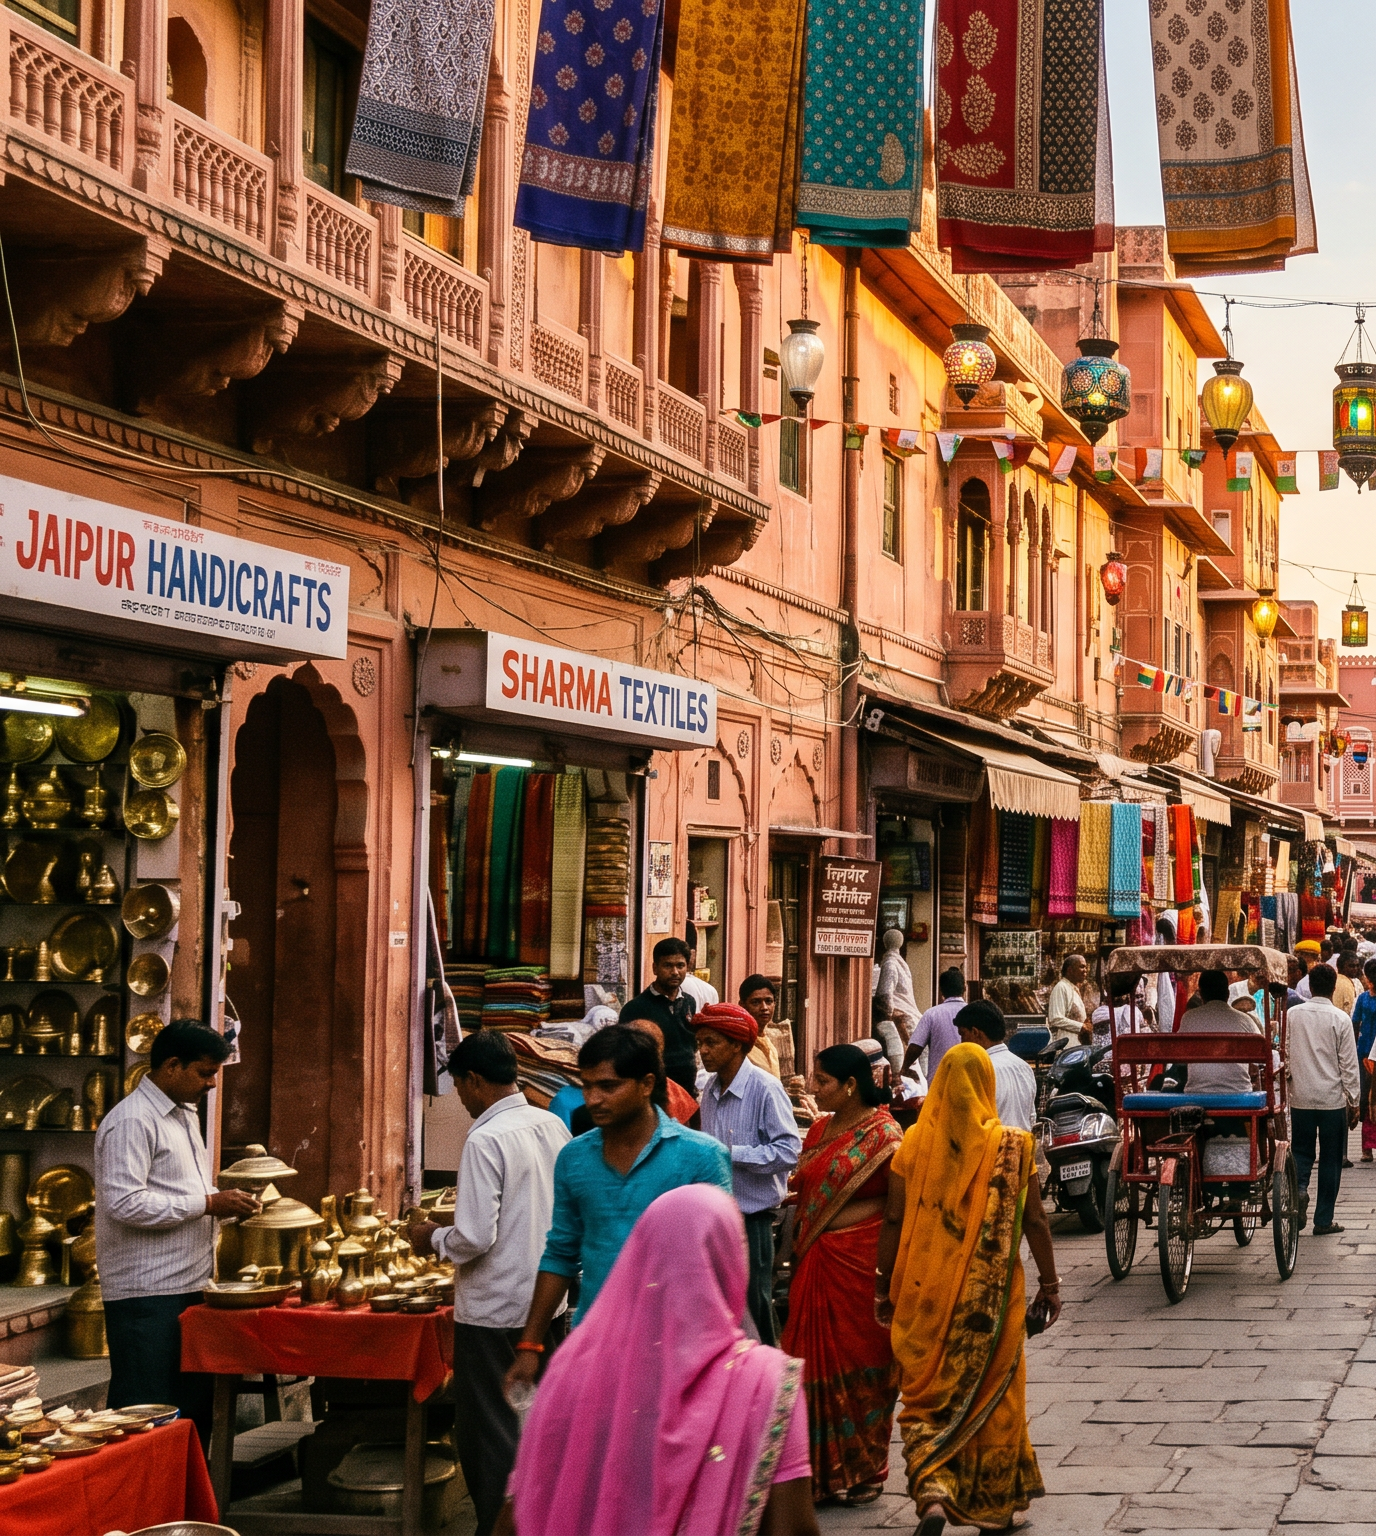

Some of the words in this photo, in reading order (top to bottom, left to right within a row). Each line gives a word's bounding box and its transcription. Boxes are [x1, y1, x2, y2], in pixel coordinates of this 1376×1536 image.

[16, 509, 135, 591] JAIPUR
[147, 539, 331, 632] HANDICRAFTS
[502, 649, 613, 716] SHARMA
[619, 676, 708, 734] TEXTILES
